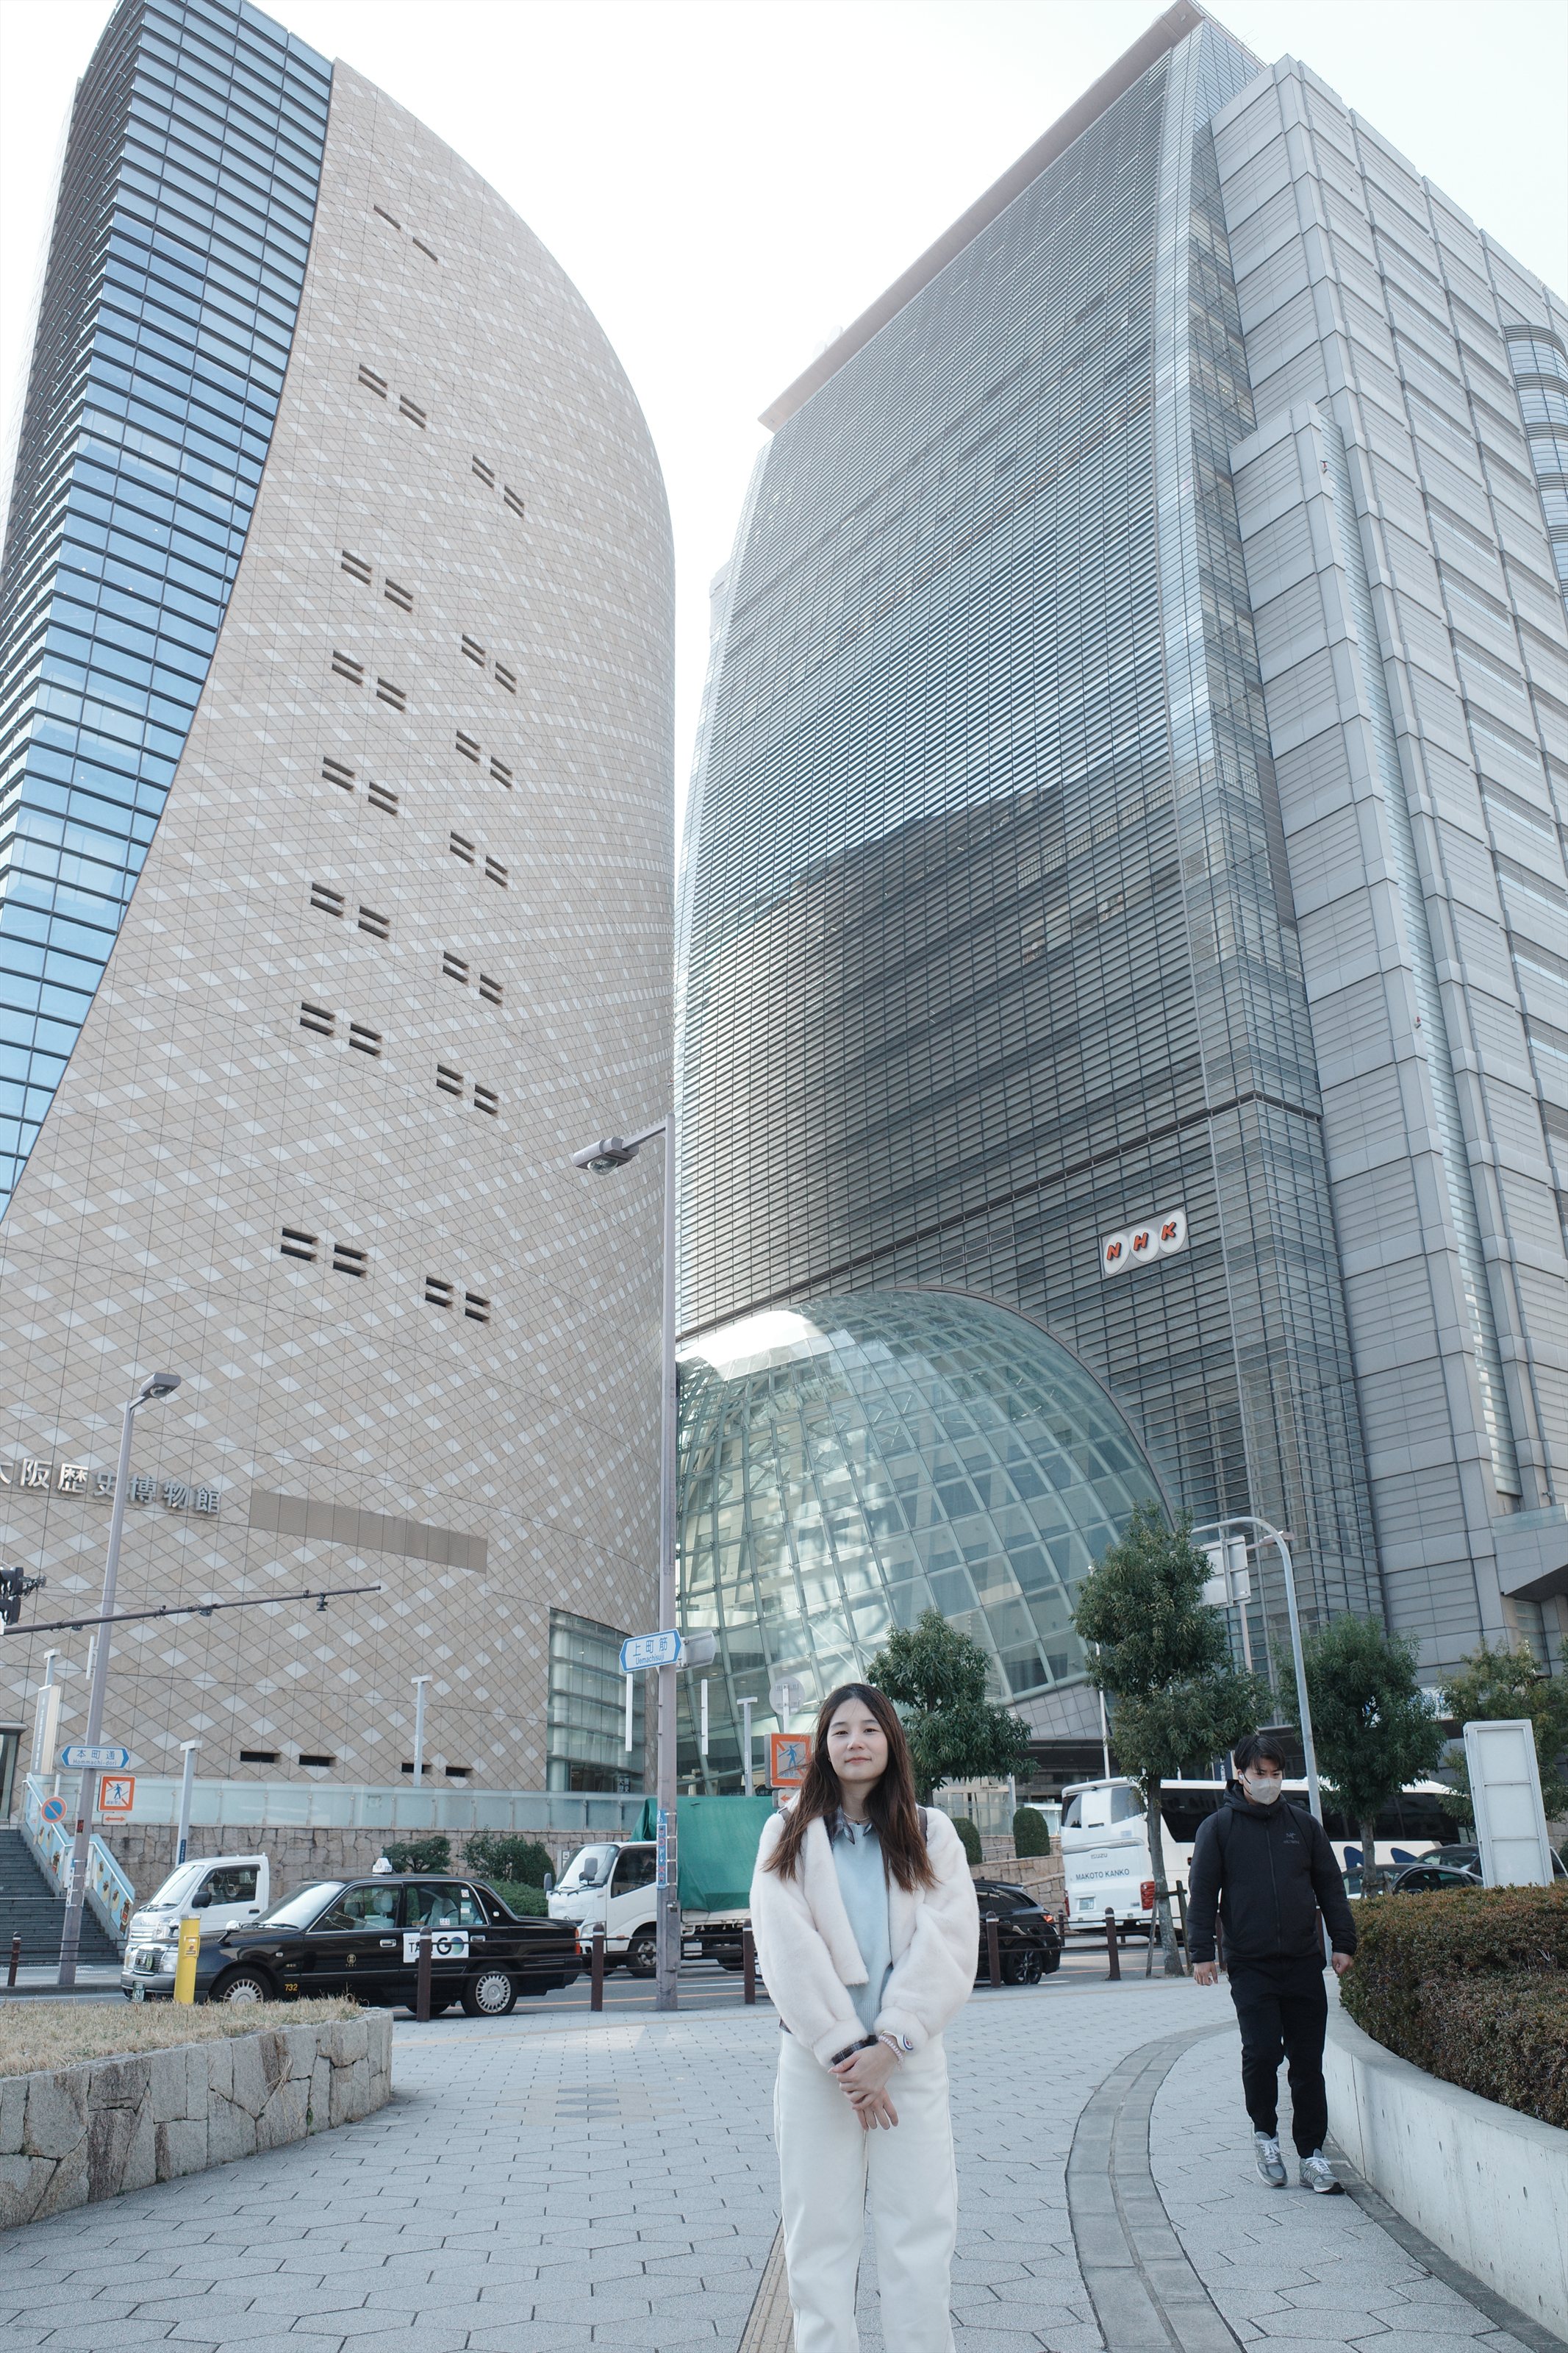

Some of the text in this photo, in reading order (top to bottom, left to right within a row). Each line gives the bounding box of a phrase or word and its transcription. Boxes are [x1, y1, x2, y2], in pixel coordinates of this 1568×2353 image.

[1106, 1221, 1177, 1261] NHK
[633, 1637, 667, 1657] 上町筋
[635, 1652, 665, 1665] Uemachisuji
[76, 1749, 115, 1760] 本町通
[1075, 1868, 1130, 1880] MAKOTO KANKO
[284, 1983, 298, 1992] 732
